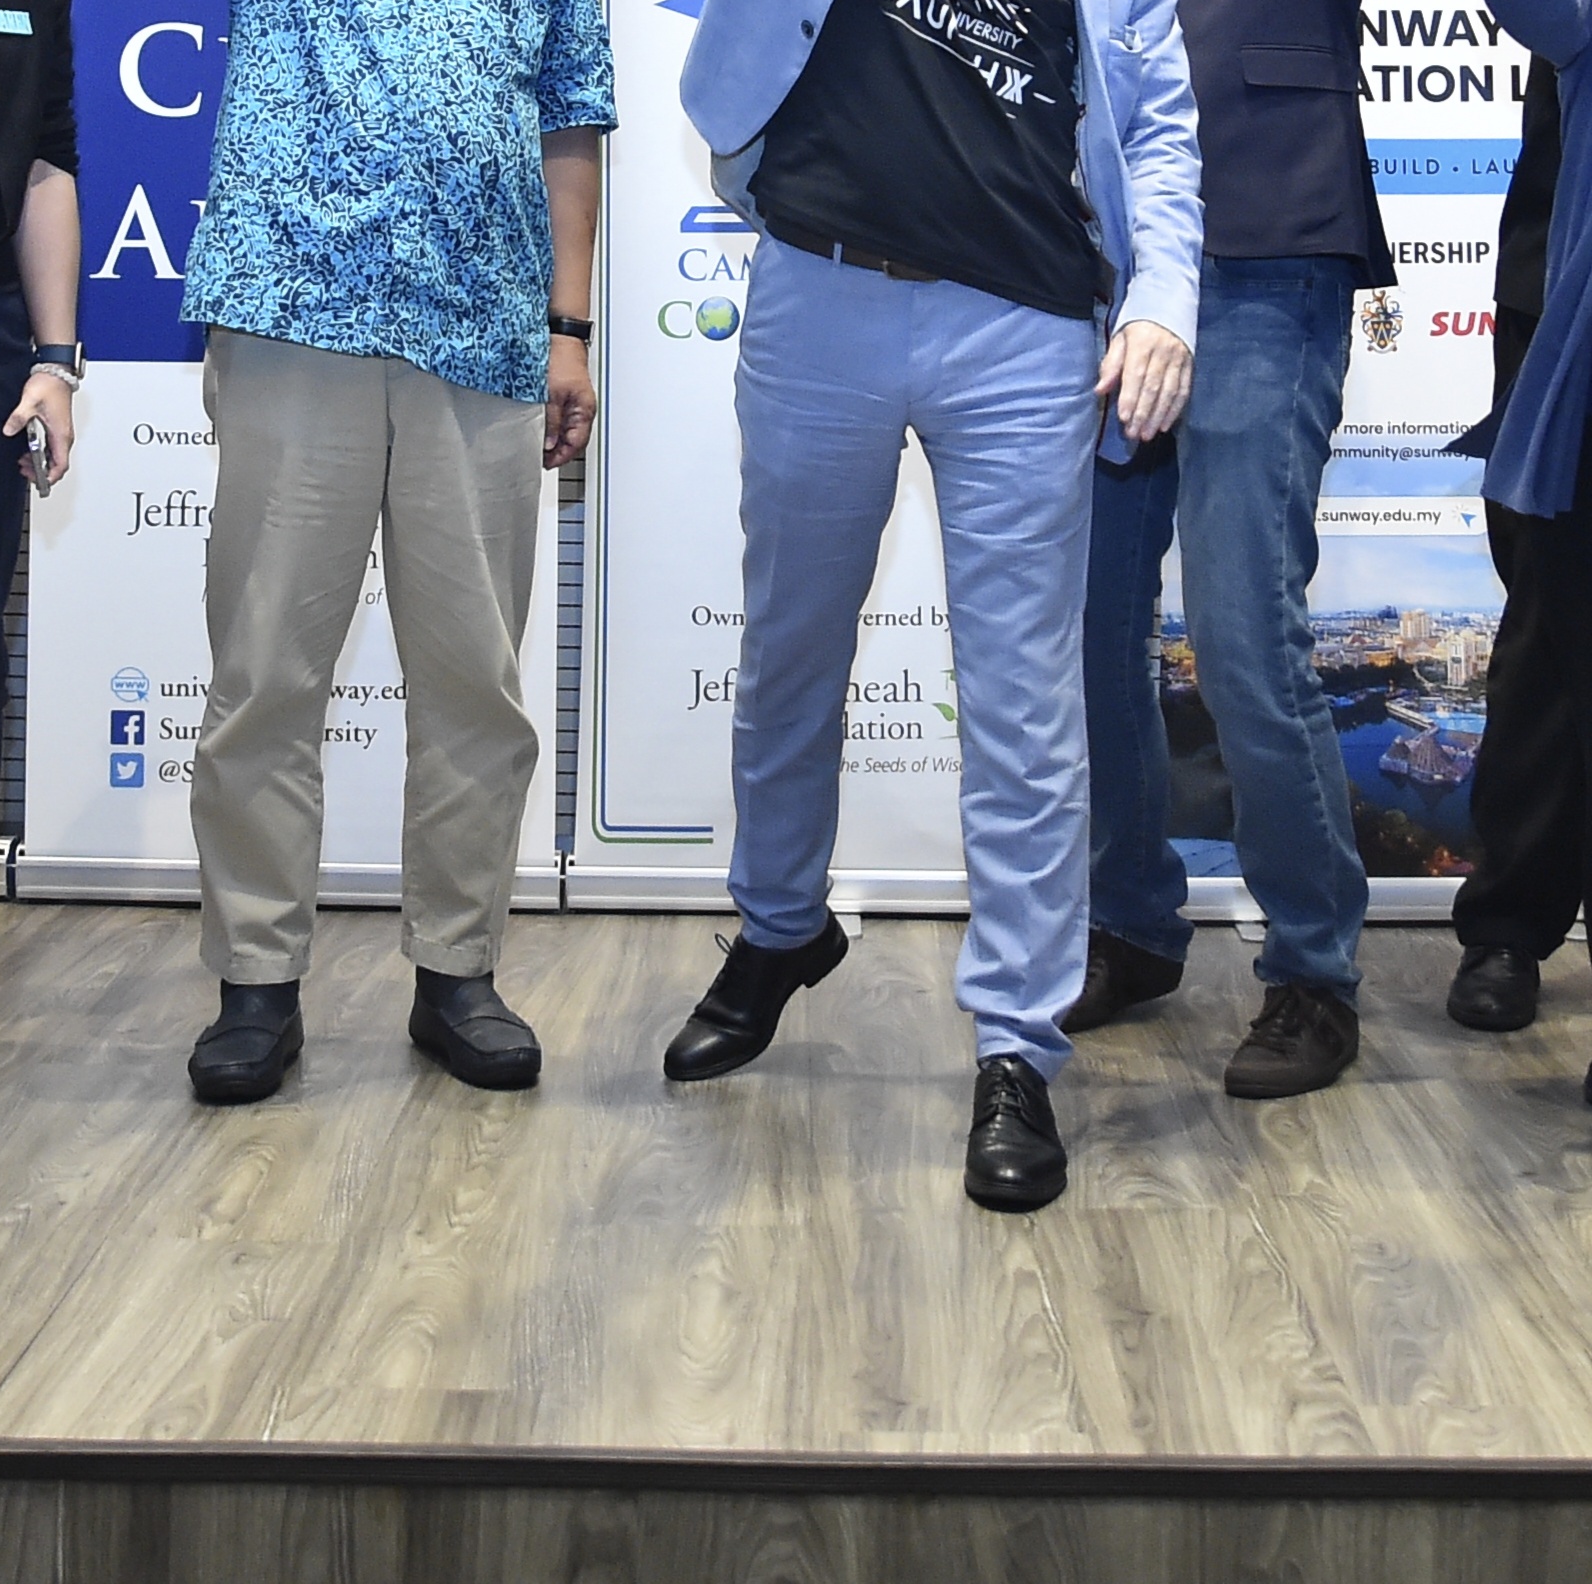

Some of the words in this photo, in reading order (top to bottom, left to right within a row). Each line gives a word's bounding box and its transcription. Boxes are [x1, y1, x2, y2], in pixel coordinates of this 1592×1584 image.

[1358, 9, 1505, 47] NWAY
[1369, 159, 1440, 175] BUILD
[1471, 159, 1518, 175] LAU
[1391, 241, 1490, 264] ERSHIP
[1429, 311, 1496, 337] SUN
[132, 422, 217, 446] Owned
[1343, 424, 1384, 435] more
[127, 490, 215, 536] Jeffr
[1316, 508, 1442, 526] .sunway.edu.my
[691, 605, 745, 627] Own
[858, 605, 923, 627] erned
[687, 667, 739, 711] Jef
[863, 757, 908, 774] Seeds
[911, 756, 930, 774] of
[932, 756, 964, 774] Wis
